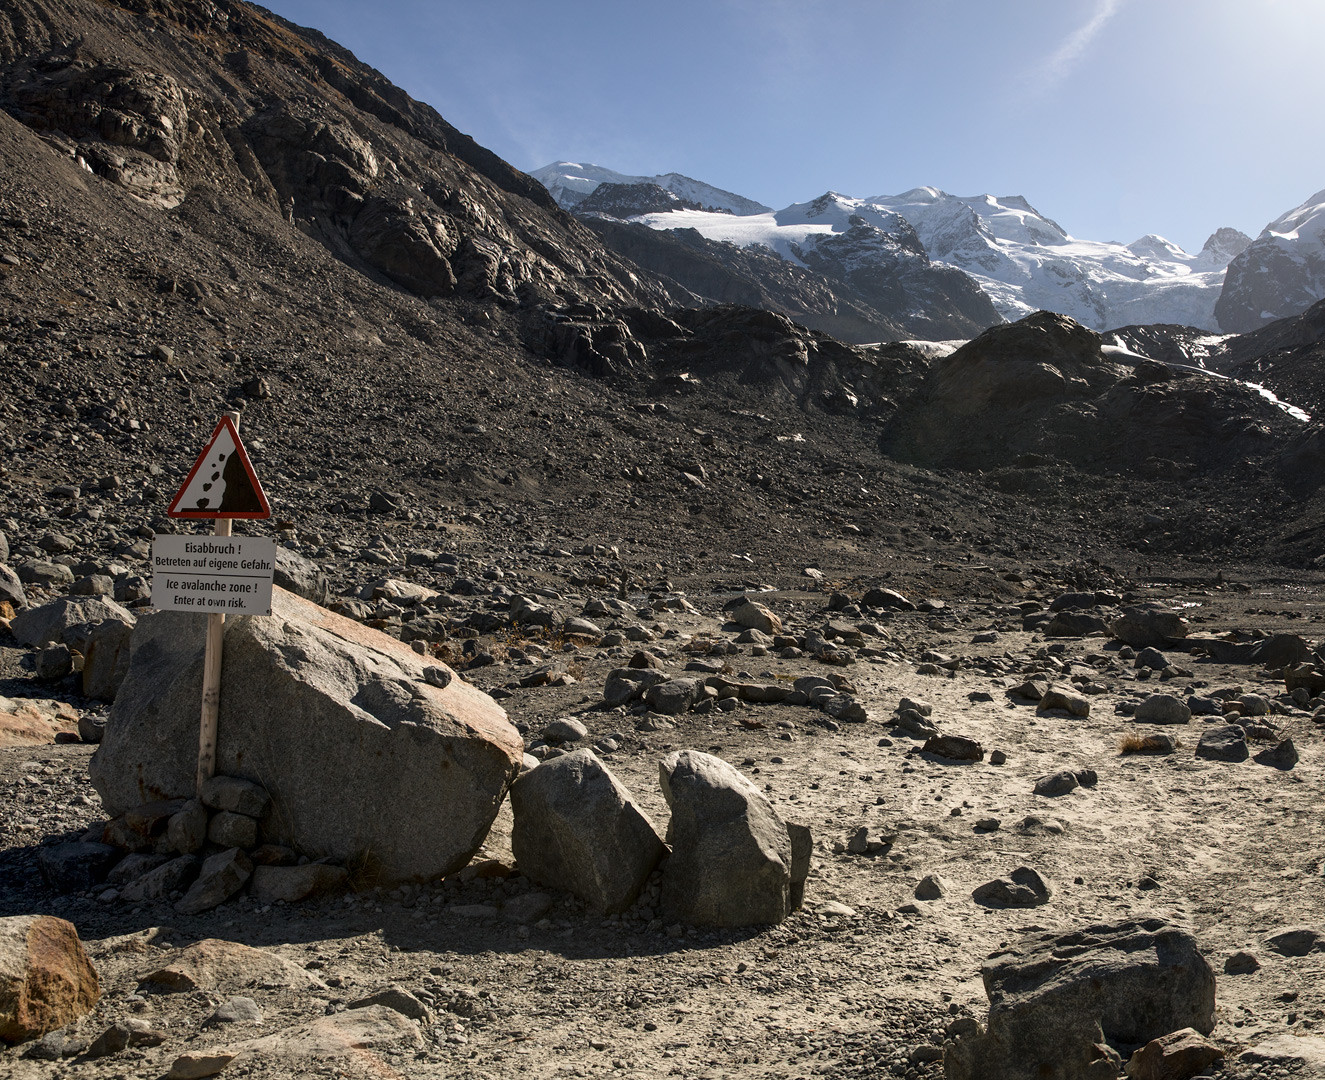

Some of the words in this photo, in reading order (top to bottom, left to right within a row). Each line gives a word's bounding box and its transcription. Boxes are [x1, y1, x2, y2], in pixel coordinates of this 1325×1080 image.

[185, 542, 235, 554] Eisabbruch
[237, 545, 242, 554] !
[155, 557, 191, 566] Betreten
[193, 558, 207, 567] auf
[208, 559, 239, 570] eigene
[240, 560, 272, 570] Gefahr.
[166, 579, 179, 589] Ice
[181, 580, 226, 592] avalanche
[229, 584, 252, 593] zone
[254, 583, 258, 593] !
[174, 595, 195, 605] Enter
[197, 597, 206, 606] at
[207, 599, 226, 607] own
[228, 598, 247, 608] risk.
